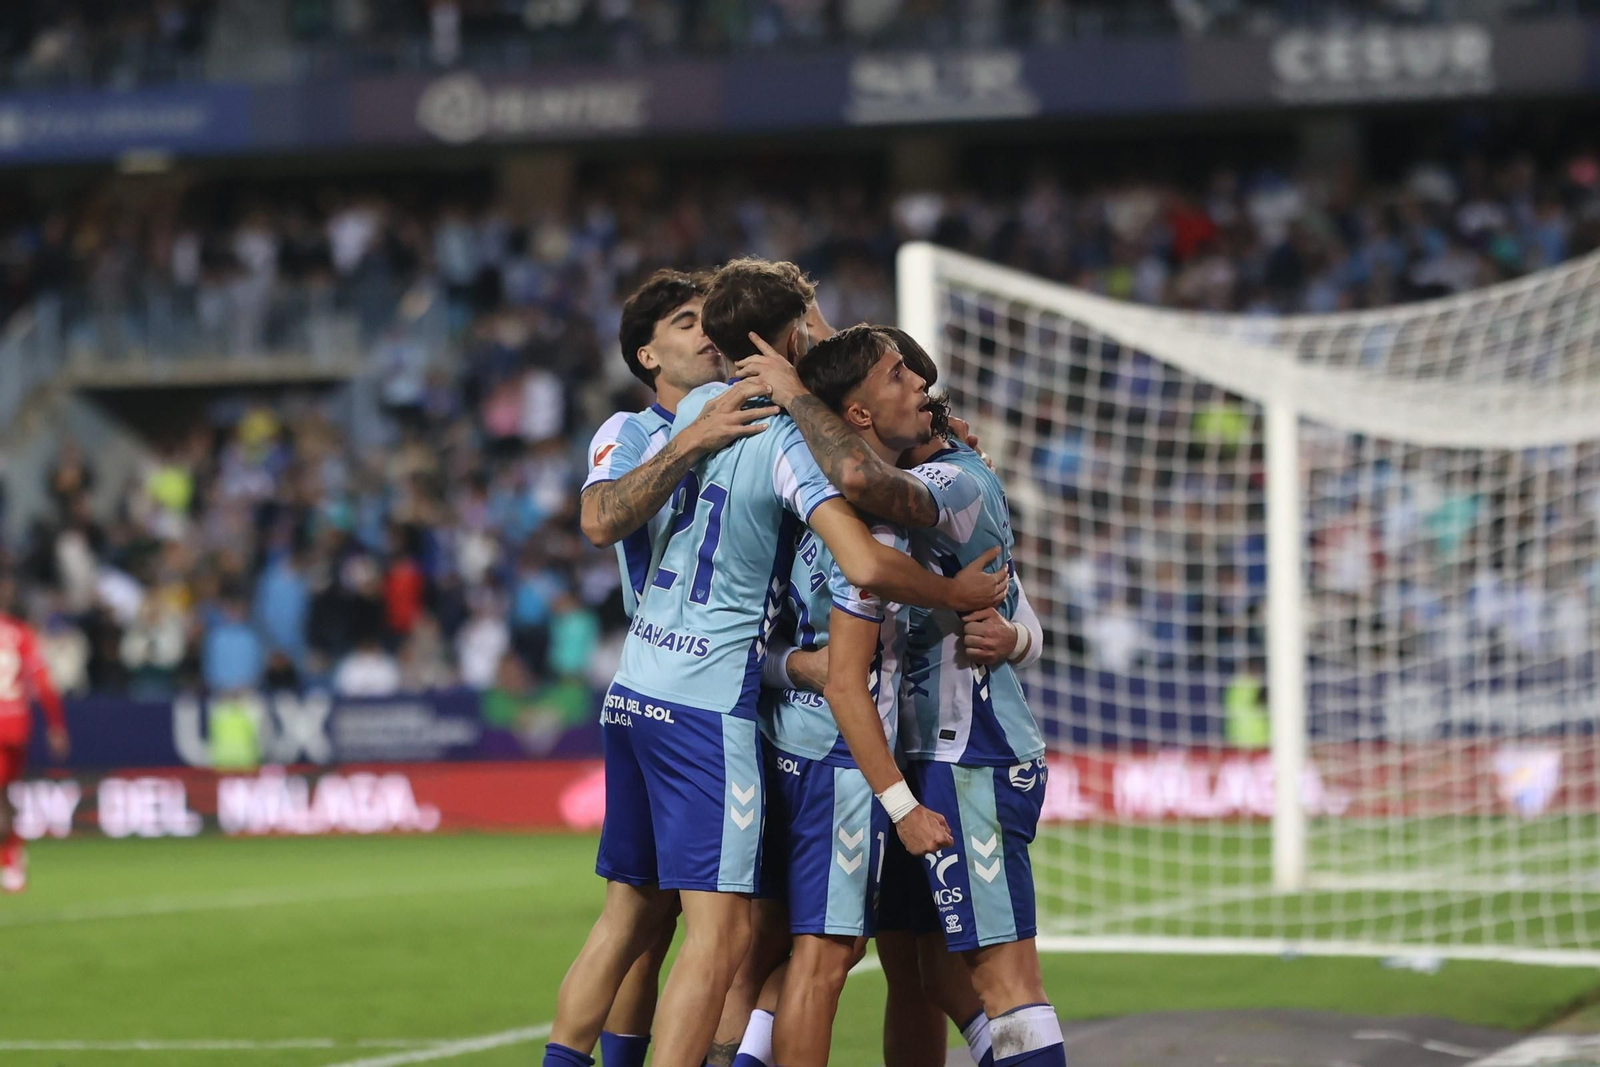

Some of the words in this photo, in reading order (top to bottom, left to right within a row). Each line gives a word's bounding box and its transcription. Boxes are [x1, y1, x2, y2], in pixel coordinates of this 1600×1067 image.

[650, 468, 729, 607] 21
[626, 698, 642, 716] DEL
[644, 704, 675, 724] SOL
[776, 757, 801, 776] SOL
[932, 887, 963, 906] MGS
